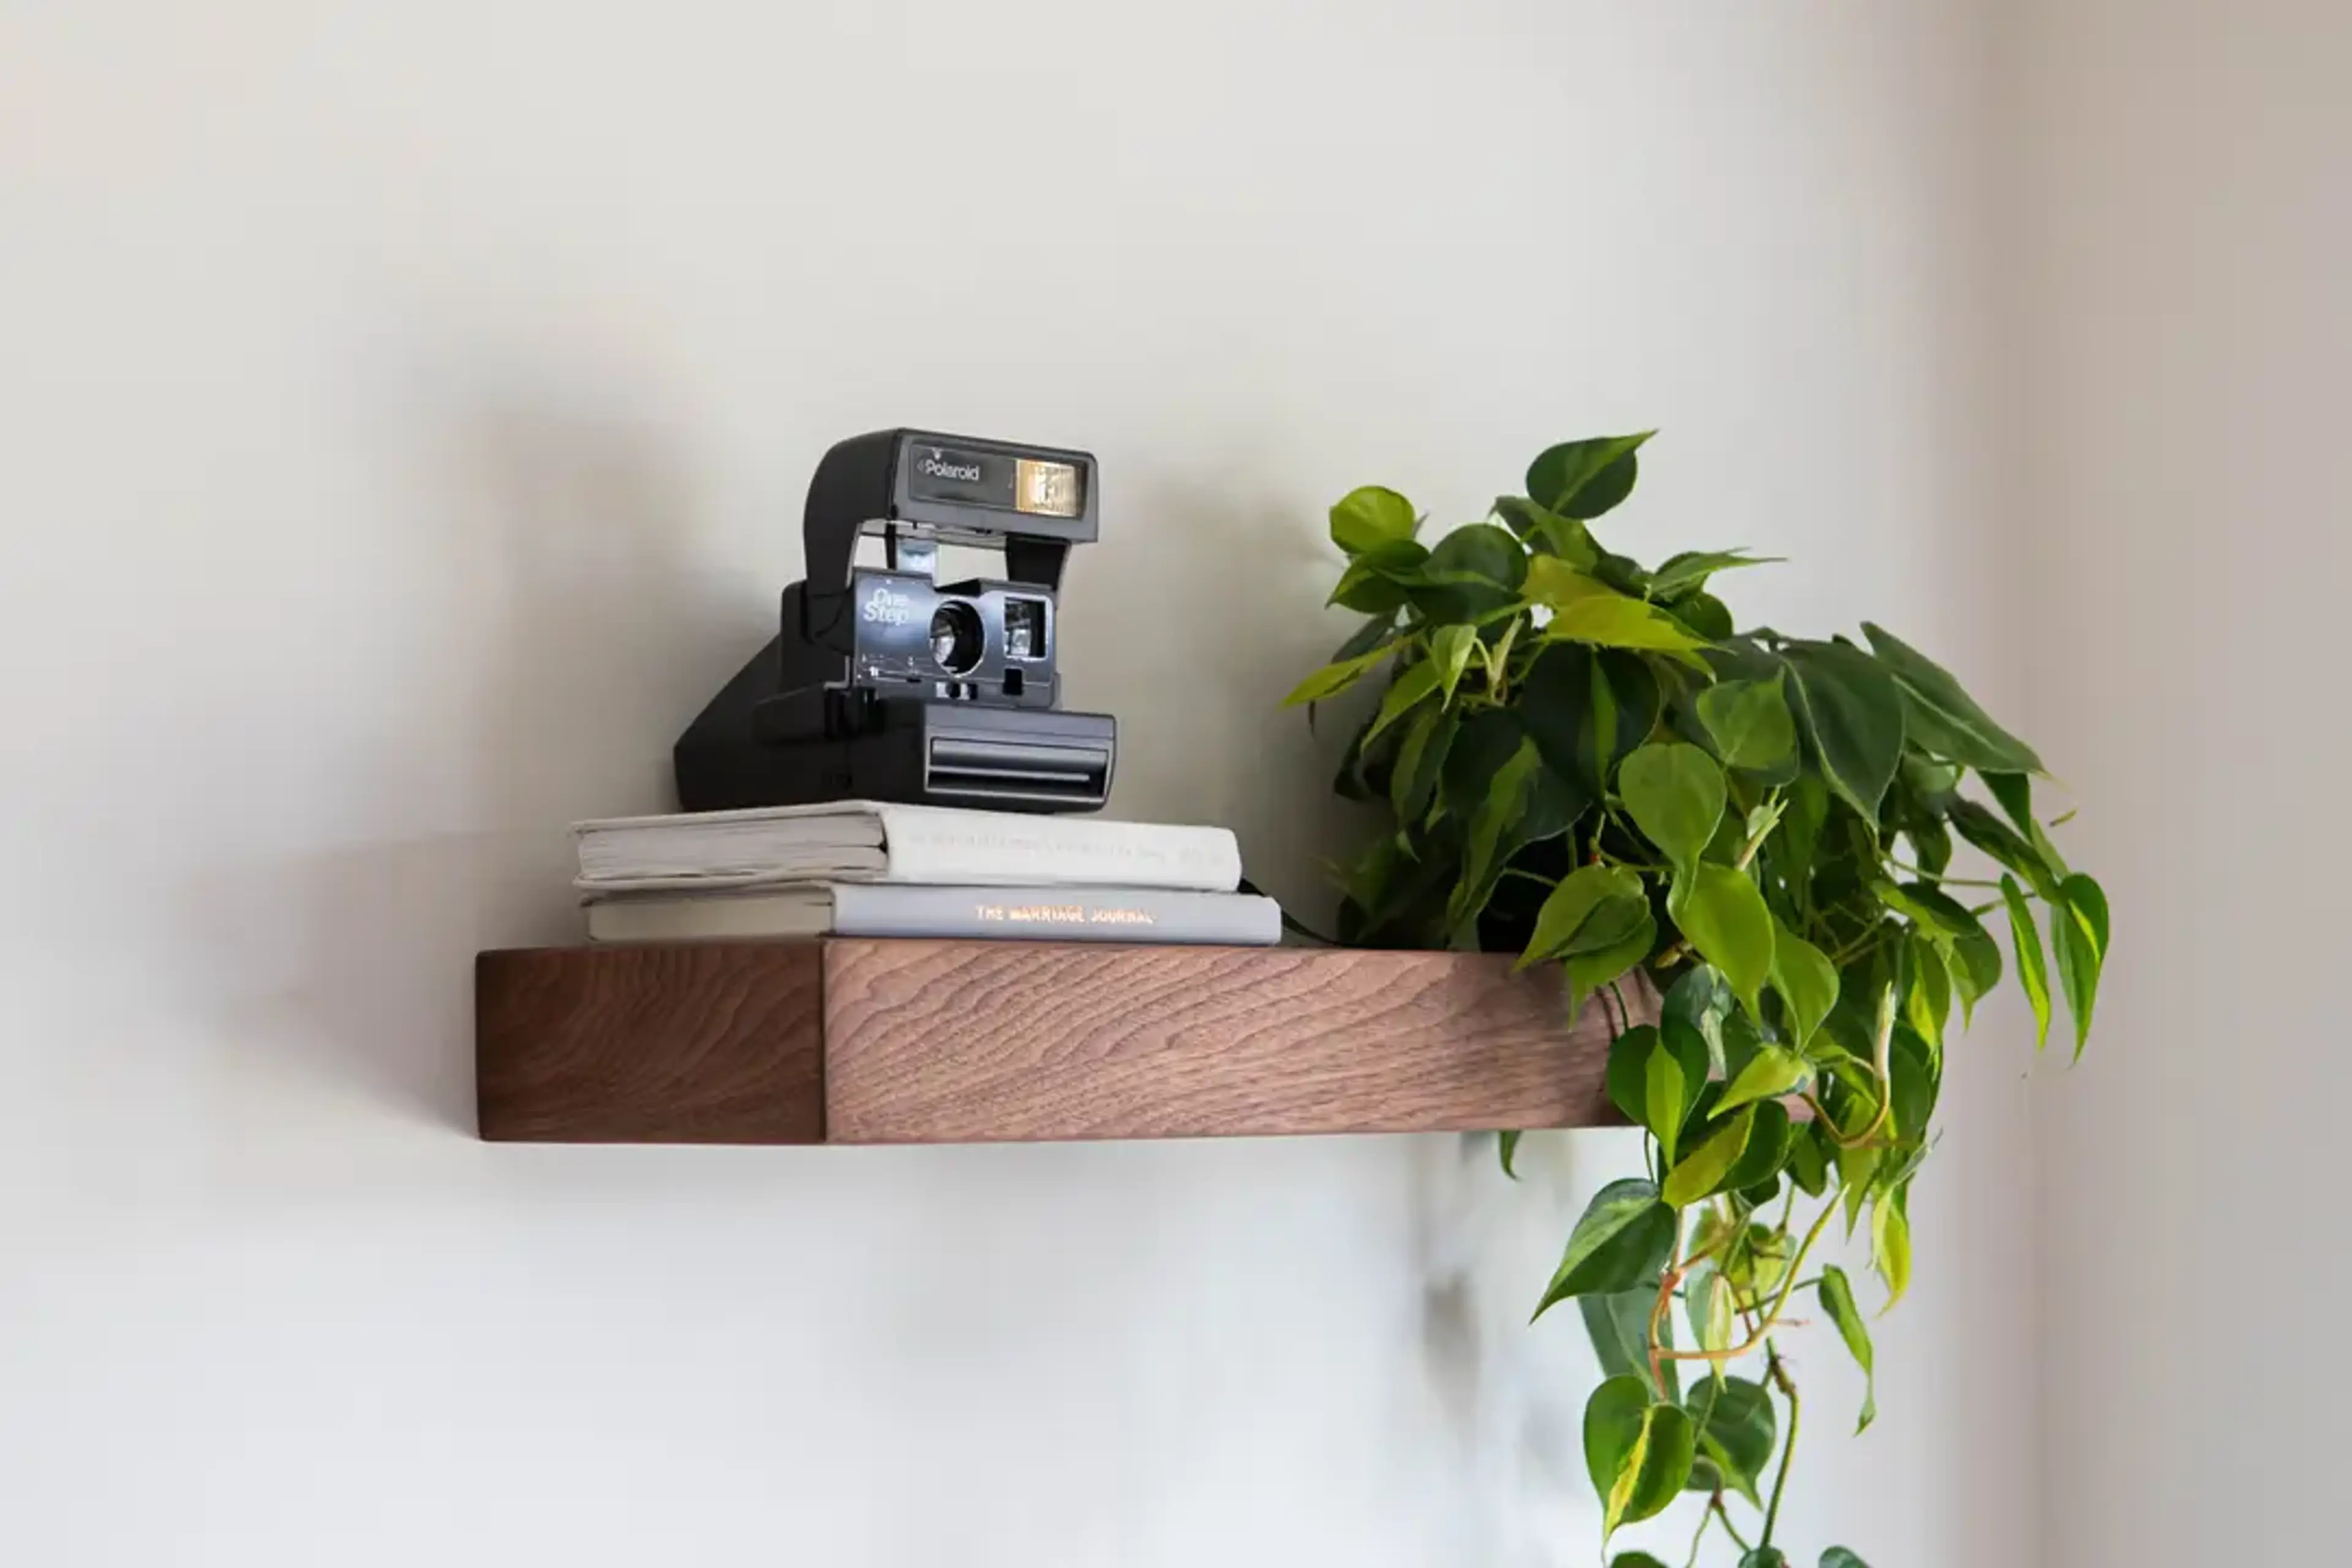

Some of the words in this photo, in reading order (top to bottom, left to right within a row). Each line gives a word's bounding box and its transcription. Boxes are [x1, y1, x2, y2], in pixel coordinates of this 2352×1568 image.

[925, 459, 979, 481] Polaroid
[873, 588, 910, 607] One
[864, 601, 909, 625] Step
[976, 905, 1003, 921] THE
